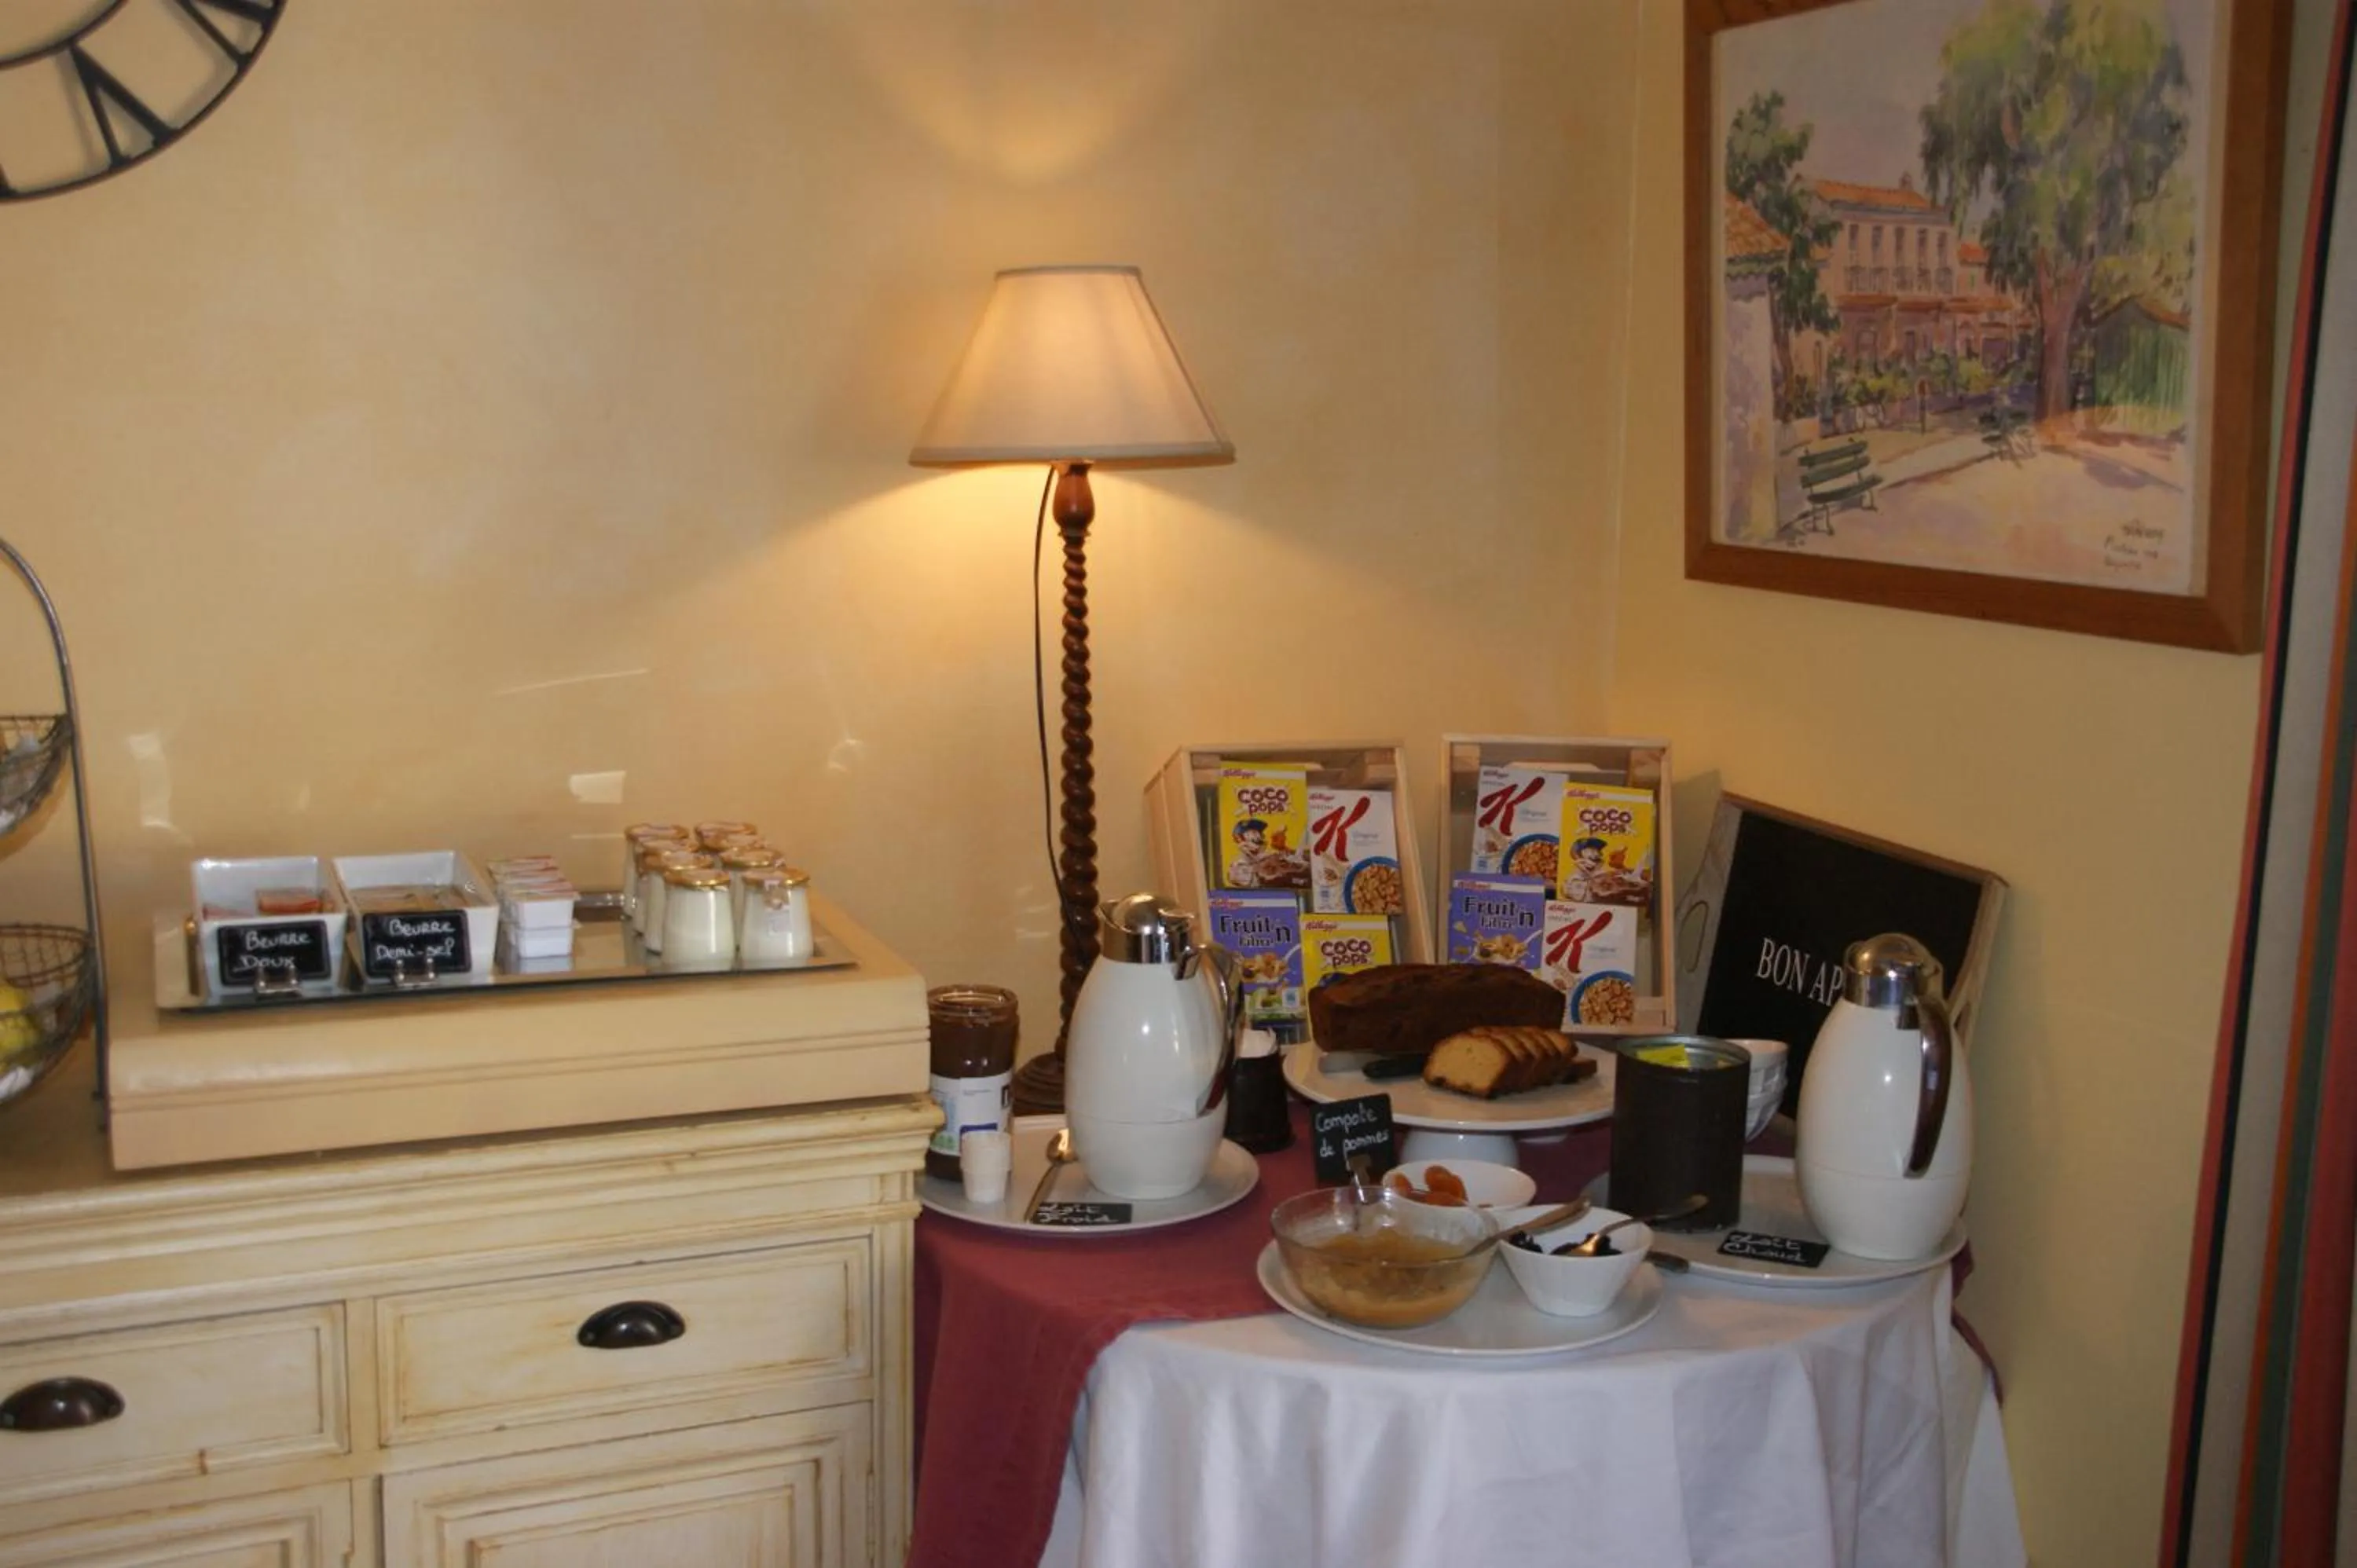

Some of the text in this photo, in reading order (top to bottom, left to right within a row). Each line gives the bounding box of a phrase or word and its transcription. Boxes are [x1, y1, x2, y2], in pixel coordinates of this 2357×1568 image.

[1311, 795, 1370, 862] K
[1478, 776, 1545, 837] K
[1545, 910, 1613, 973] K
[1756, 938, 1811, 995] BON
